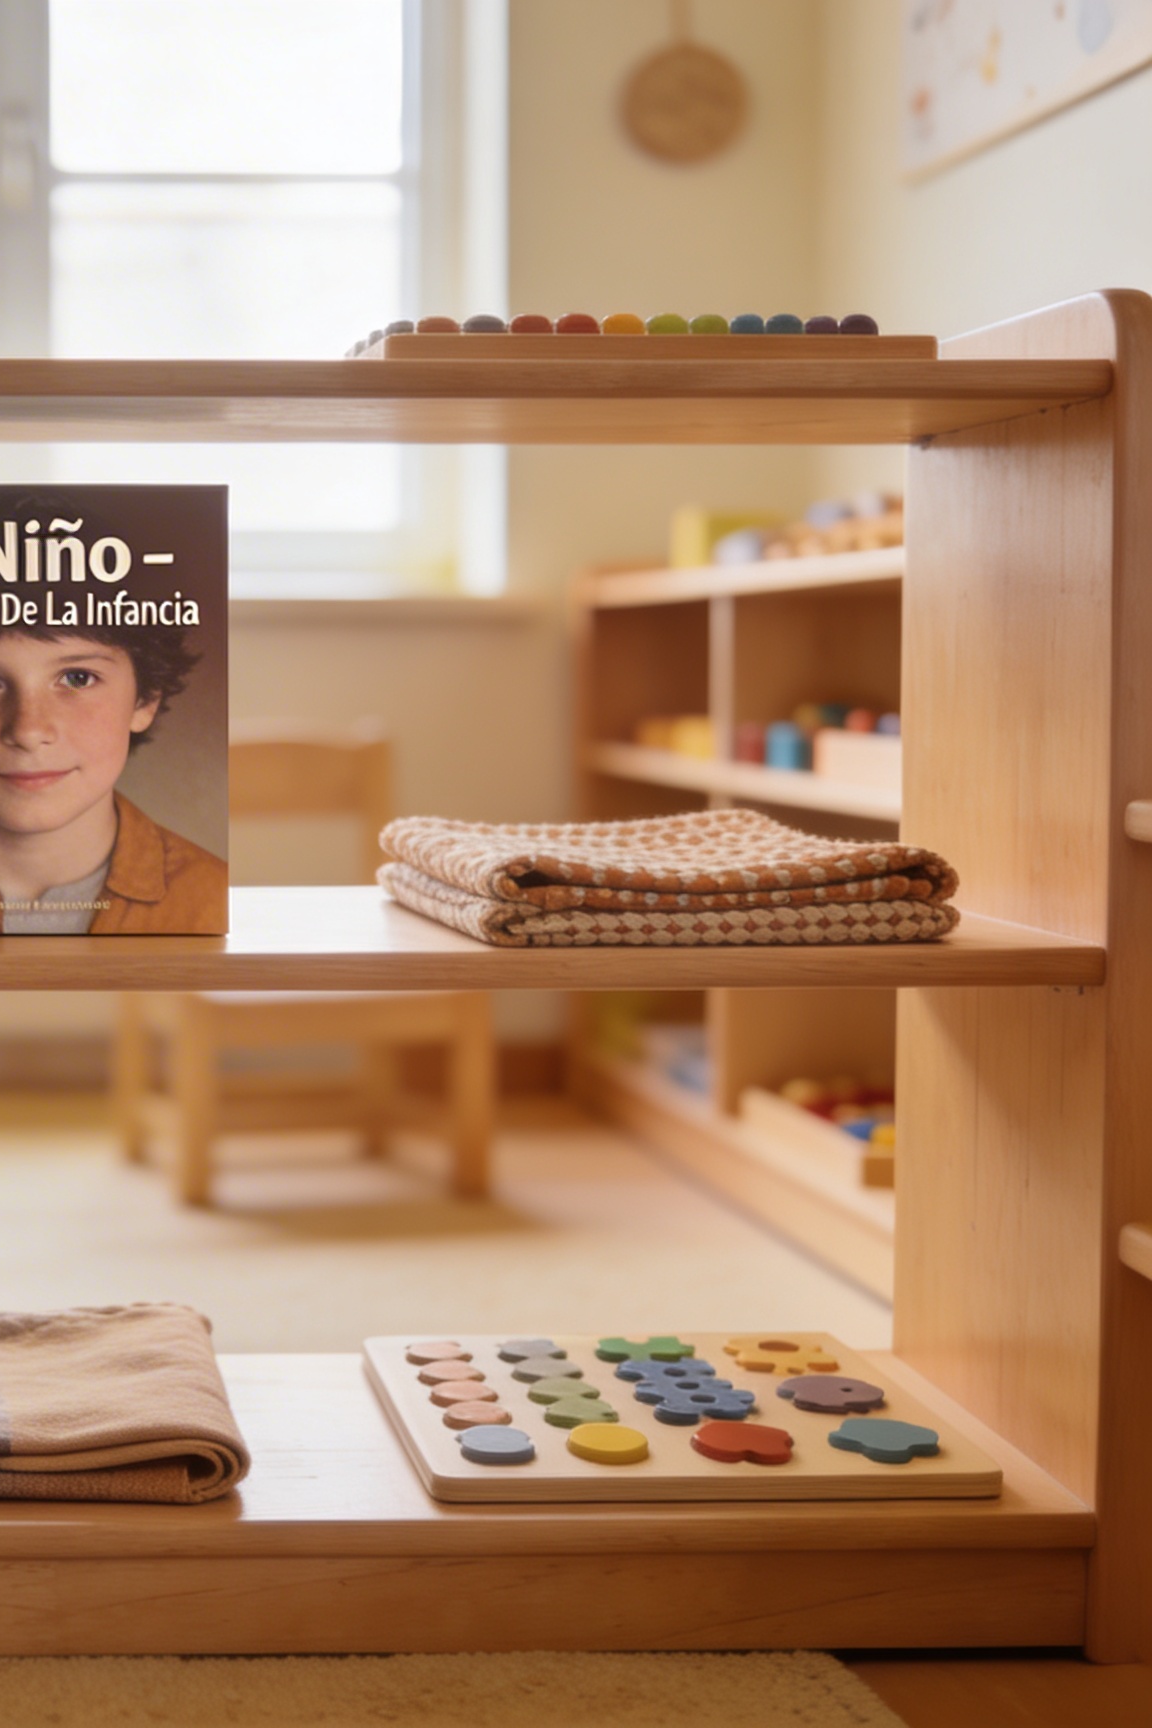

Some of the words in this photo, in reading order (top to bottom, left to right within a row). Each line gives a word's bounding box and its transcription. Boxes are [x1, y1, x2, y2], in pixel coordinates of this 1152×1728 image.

[1, 592, 38, 627] De
[46, 591, 78, 627] La
[87, 590, 201, 627] Infancia
